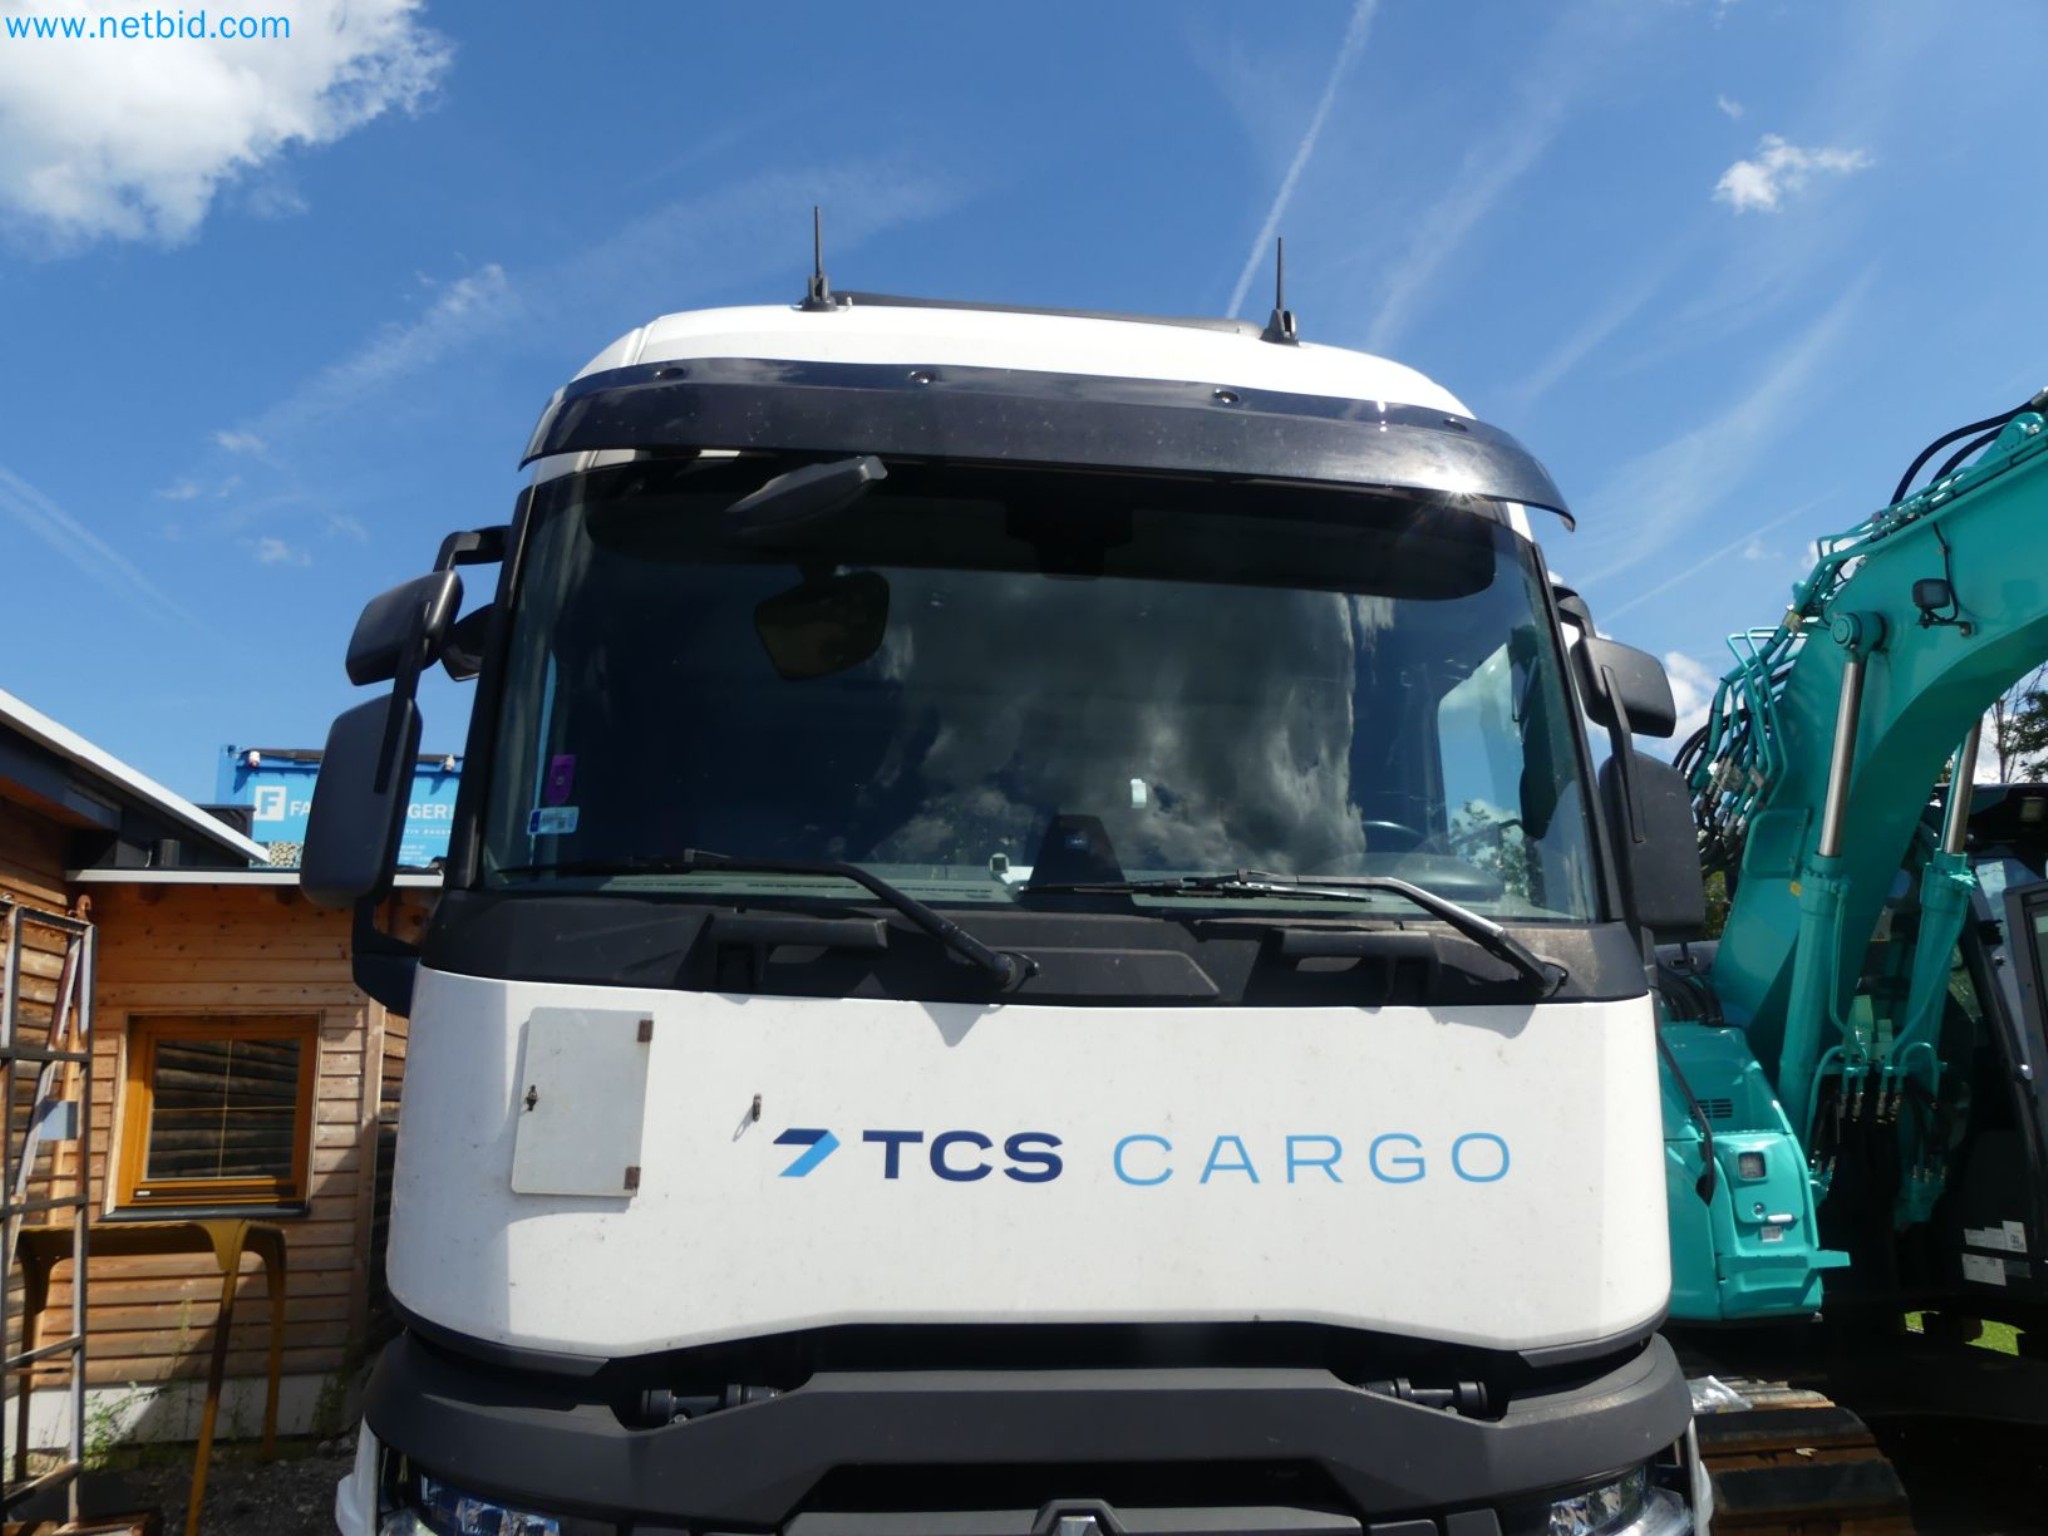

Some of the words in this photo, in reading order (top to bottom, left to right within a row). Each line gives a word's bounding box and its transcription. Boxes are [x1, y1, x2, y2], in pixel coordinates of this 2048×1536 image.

[289, 801, 312, 816] FA
[407, 803, 454, 820] GER
[863, 1129, 1063, 1183] TCS
[1112, 1131, 1512, 1187] CARGO
